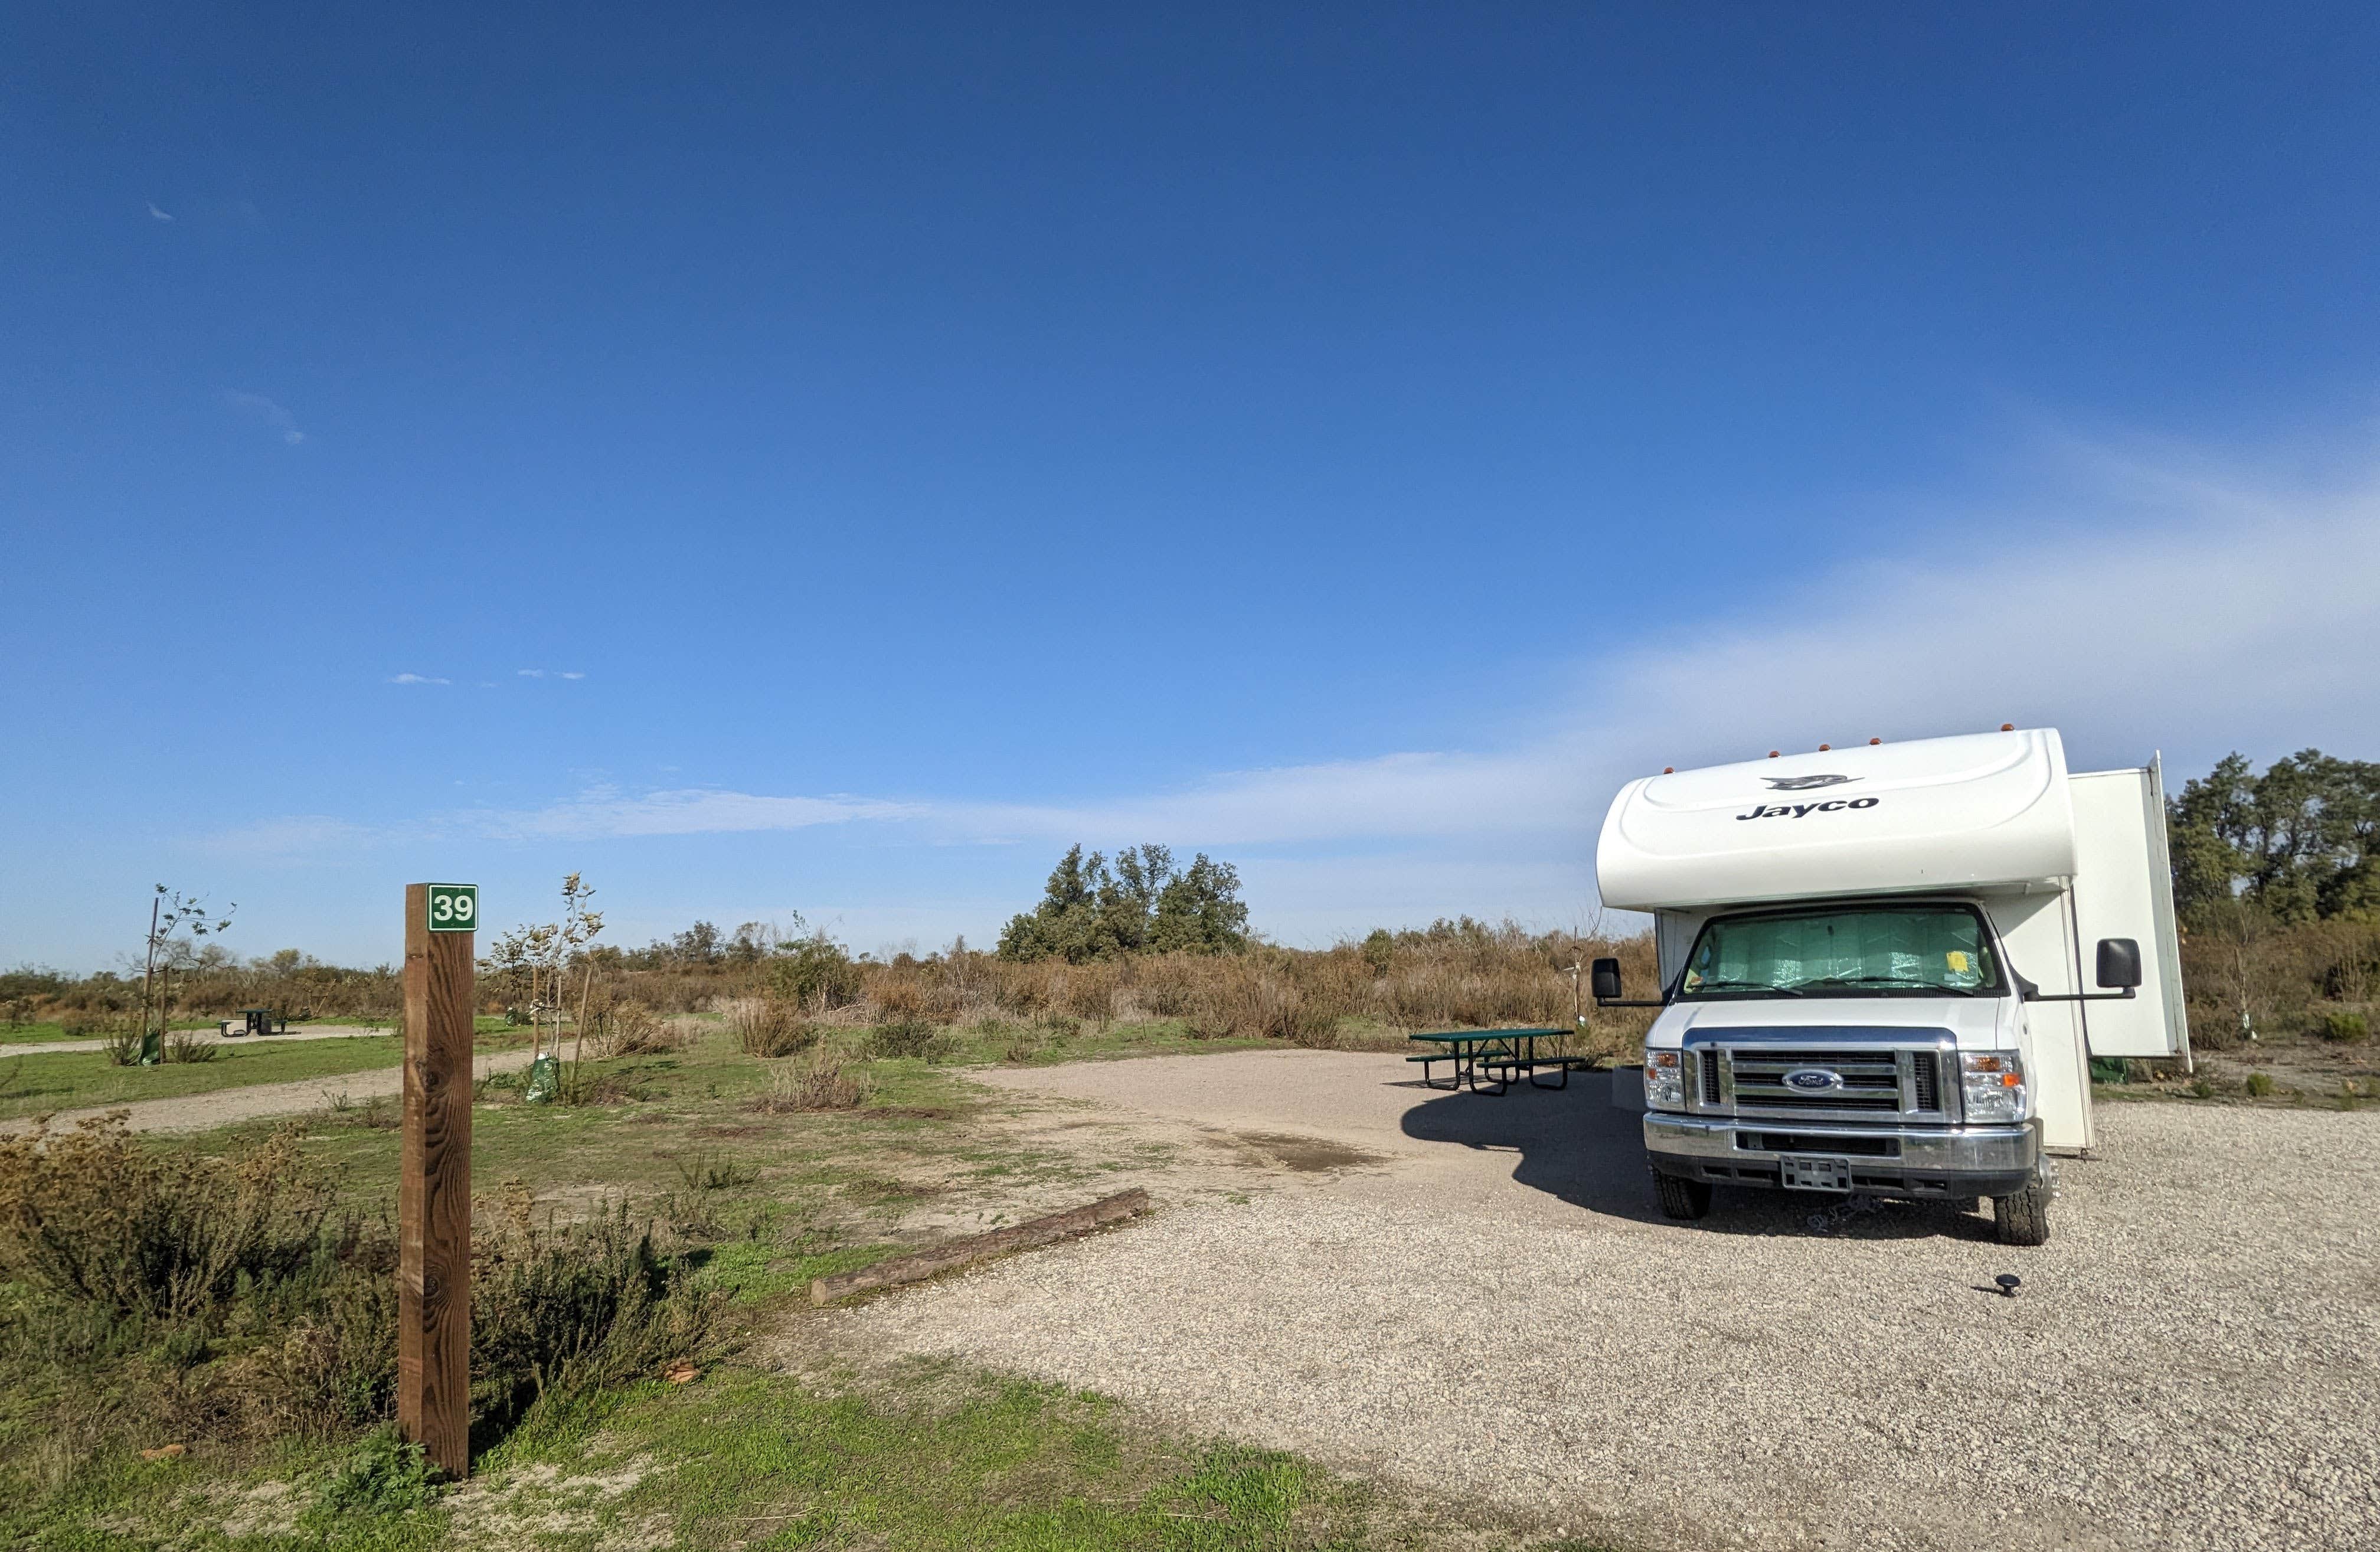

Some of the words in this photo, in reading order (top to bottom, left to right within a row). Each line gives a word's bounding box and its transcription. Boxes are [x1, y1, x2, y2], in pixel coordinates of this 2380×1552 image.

[1735, 798, 1879, 821] Jayco
[434, 895, 473, 921] 39
[1798, 1076, 1823, 1086] Ford
